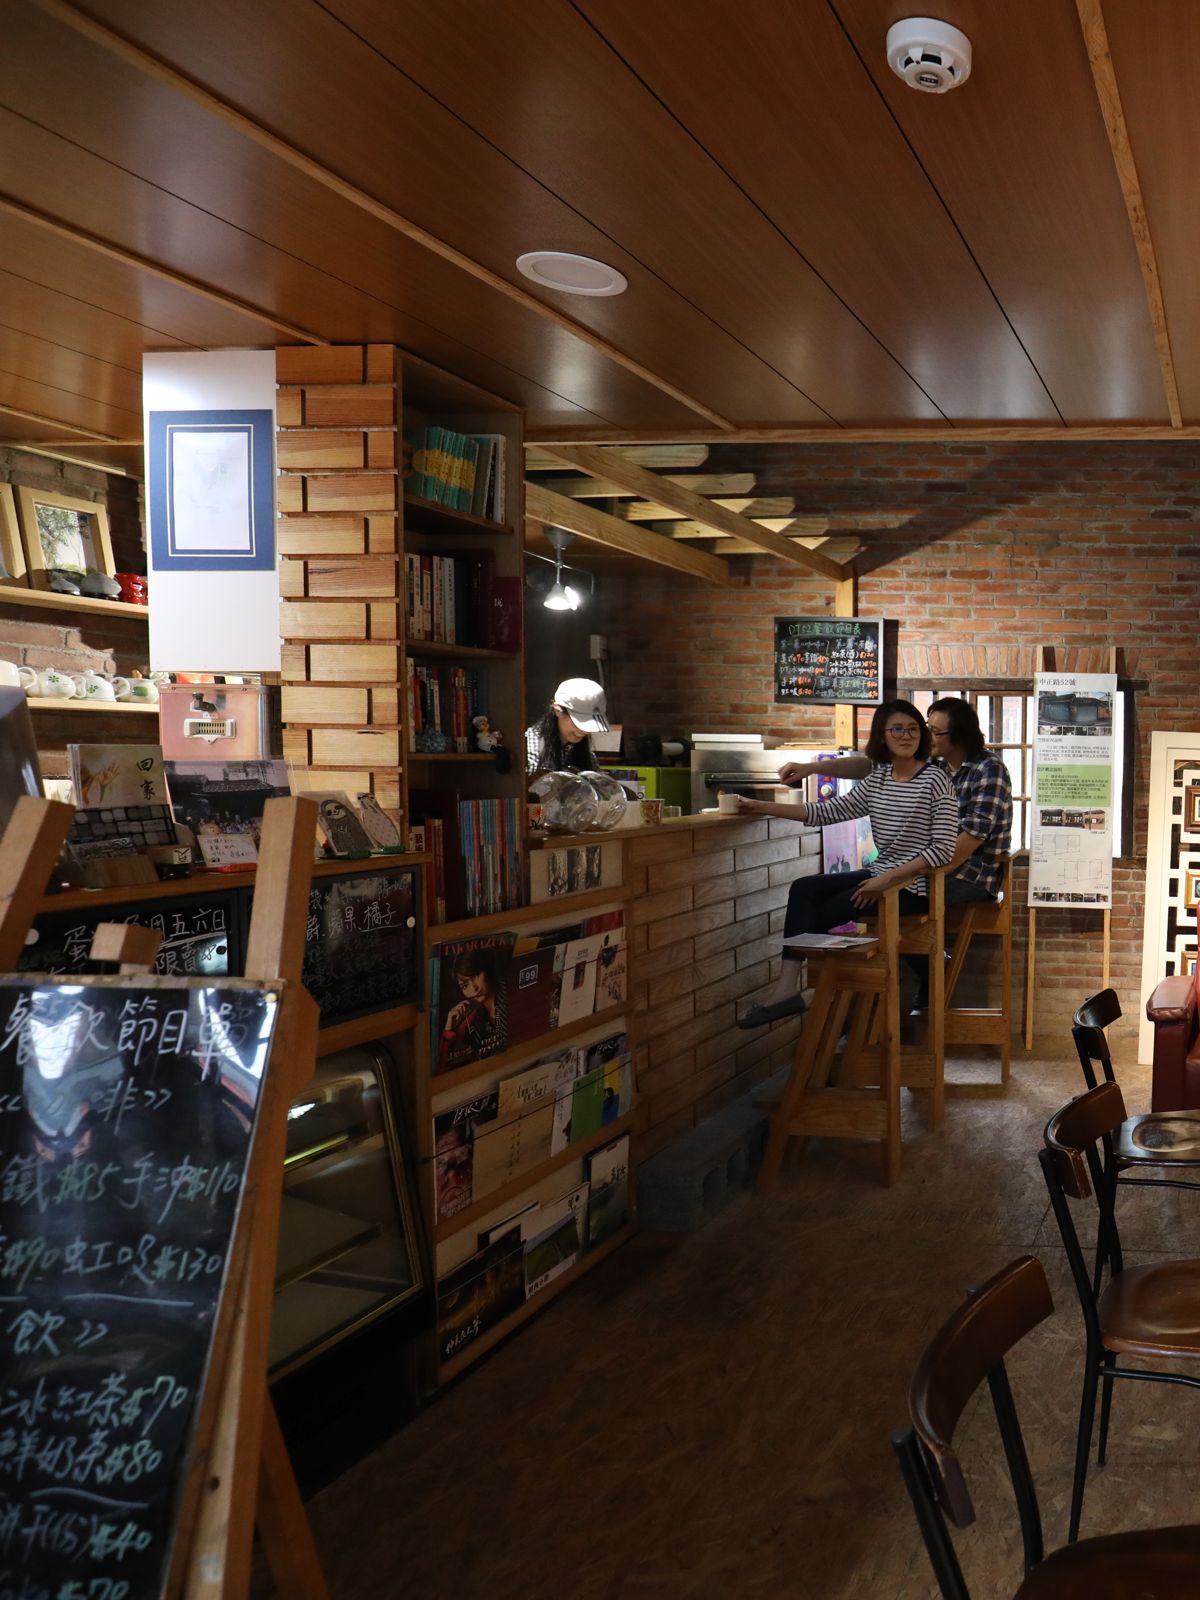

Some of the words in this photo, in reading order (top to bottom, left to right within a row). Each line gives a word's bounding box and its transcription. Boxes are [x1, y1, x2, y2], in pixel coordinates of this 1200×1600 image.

[1039, 678, 1076, 687] 中正路52號
[137, 758, 156, 800] 回家
